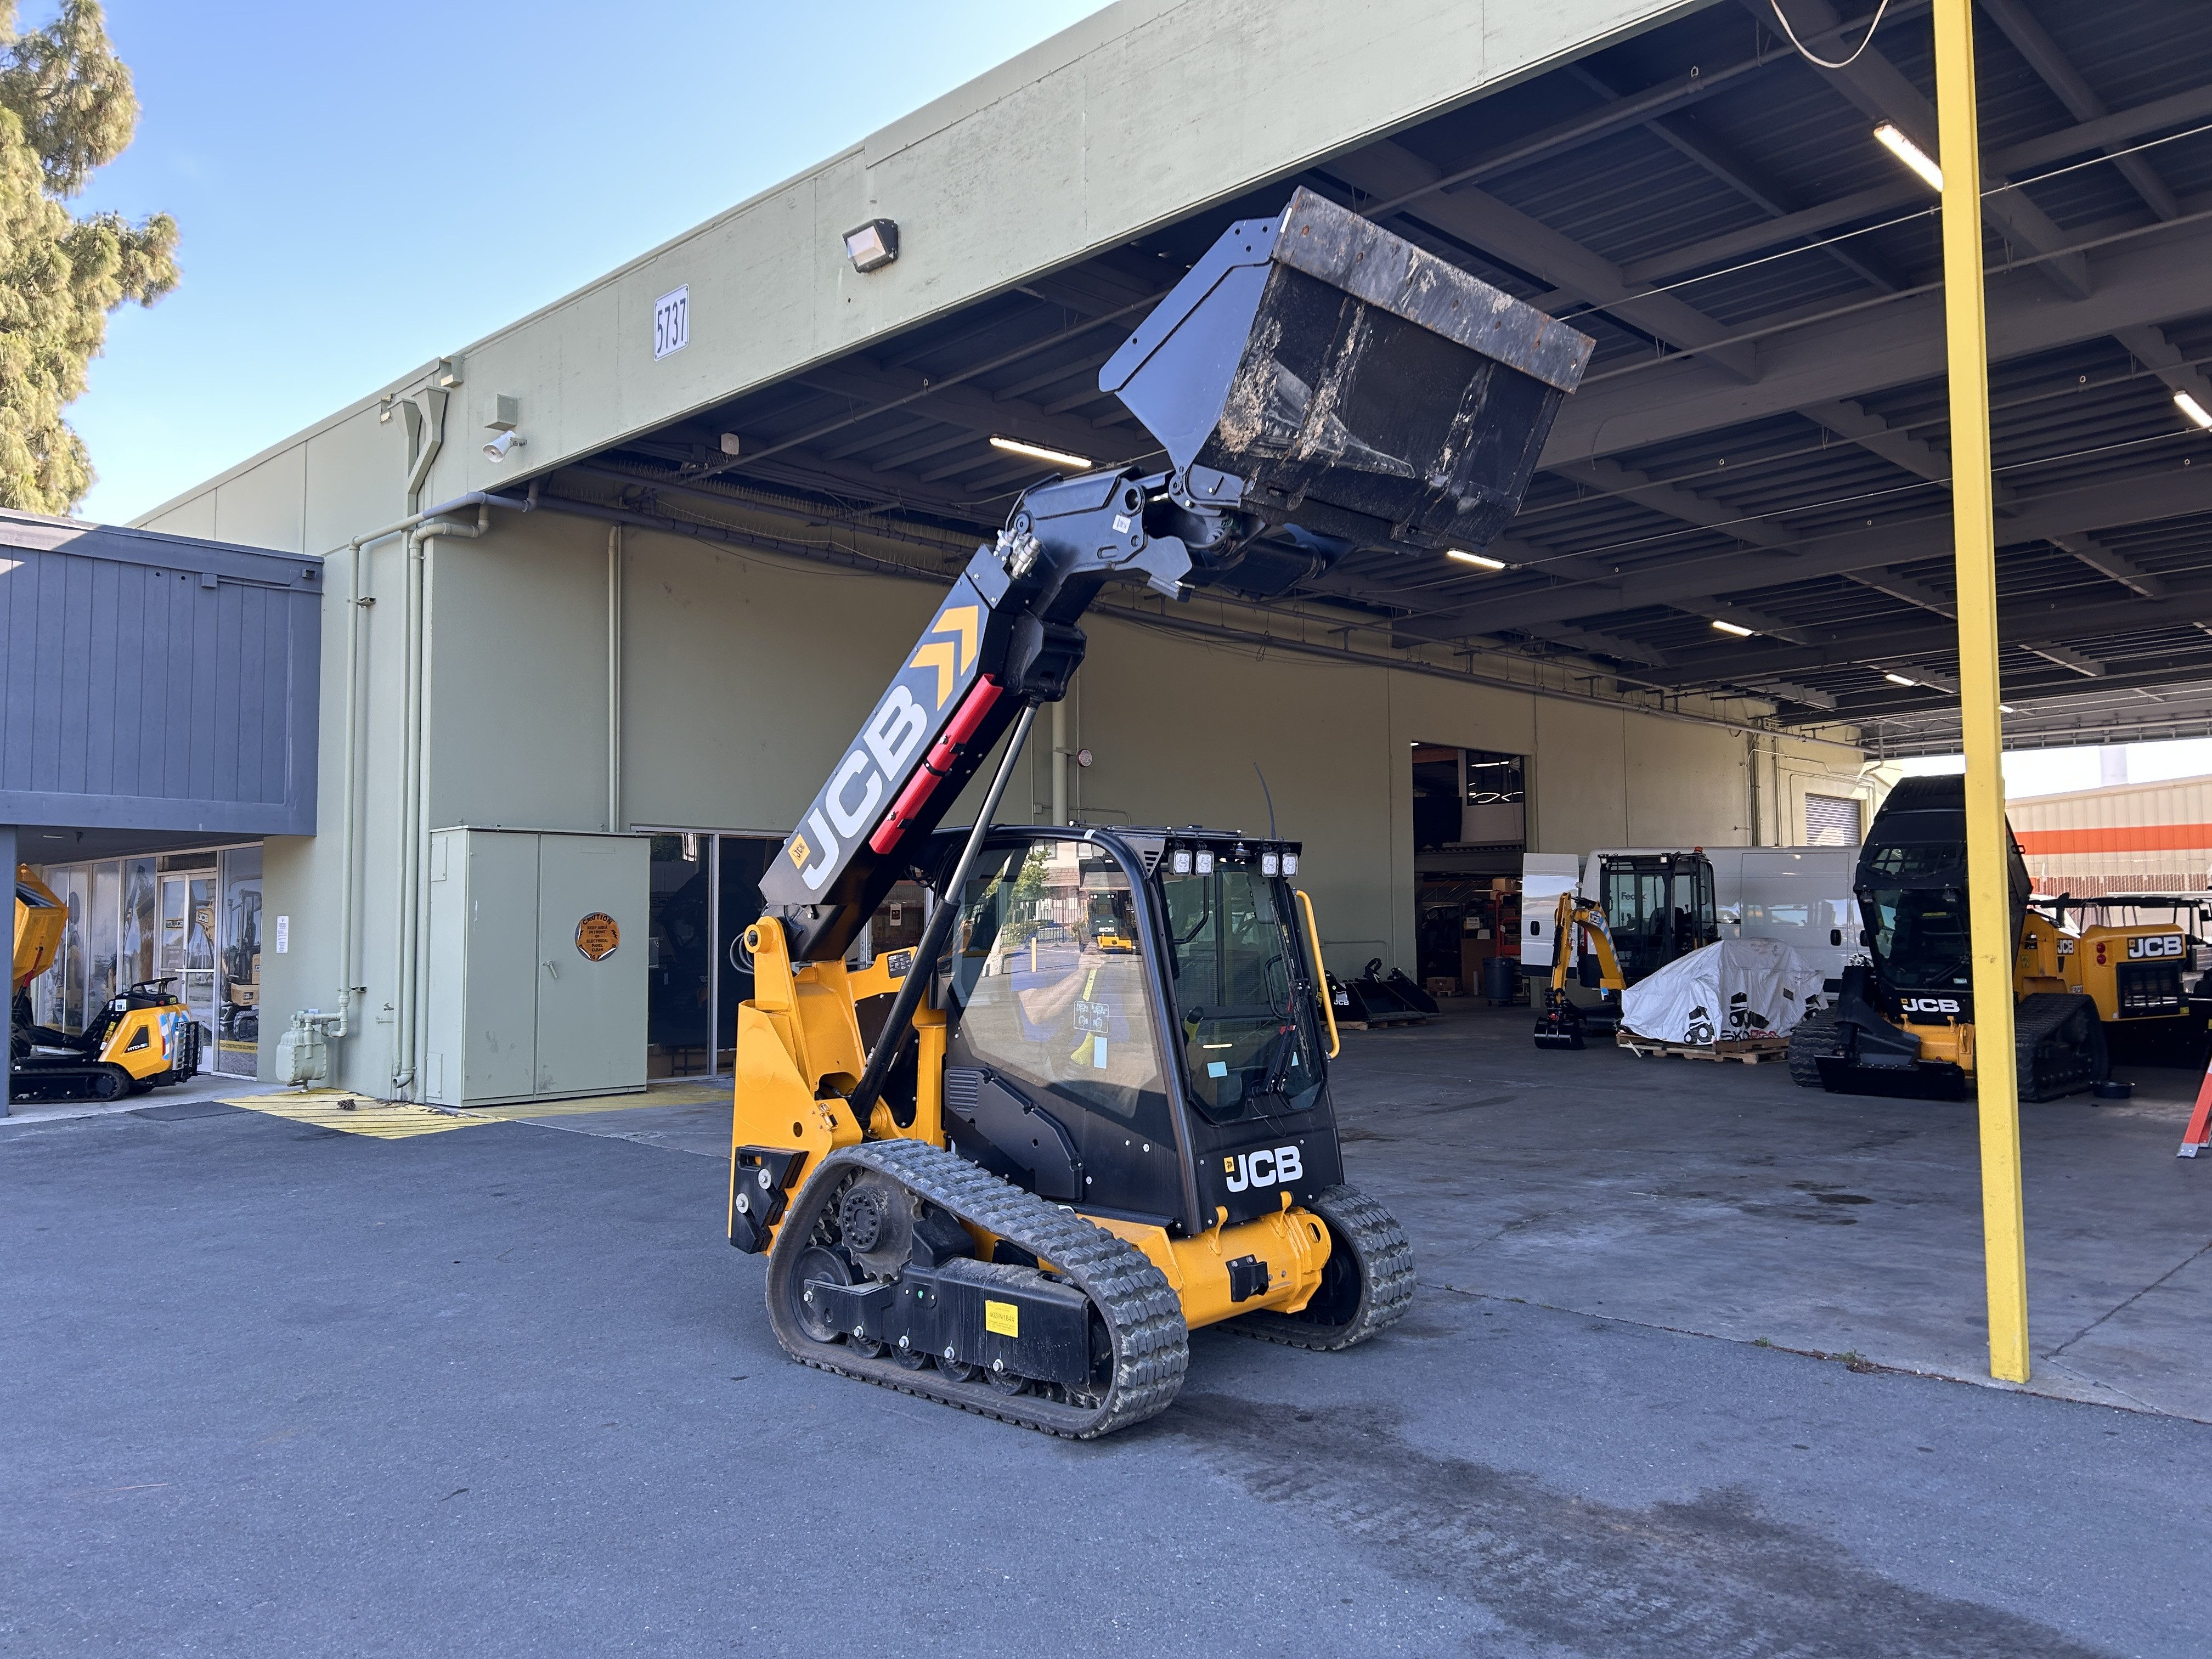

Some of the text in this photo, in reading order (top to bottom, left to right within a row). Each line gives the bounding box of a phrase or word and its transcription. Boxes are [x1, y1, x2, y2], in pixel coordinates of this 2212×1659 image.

[657, 297, 686, 354] 5737
[802, 685, 928, 890] JCB
[794, 844, 804, 858] JCB
[198, 912, 208, 923] JCB
[583, 914, 613, 925] CAUTION
[2057, 939, 2074, 954] JCB
[2129, 936, 2182, 958] JCB
[1902, 998, 1960, 1013] JCB
[1226, 1145, 1304, 1193] JCB
